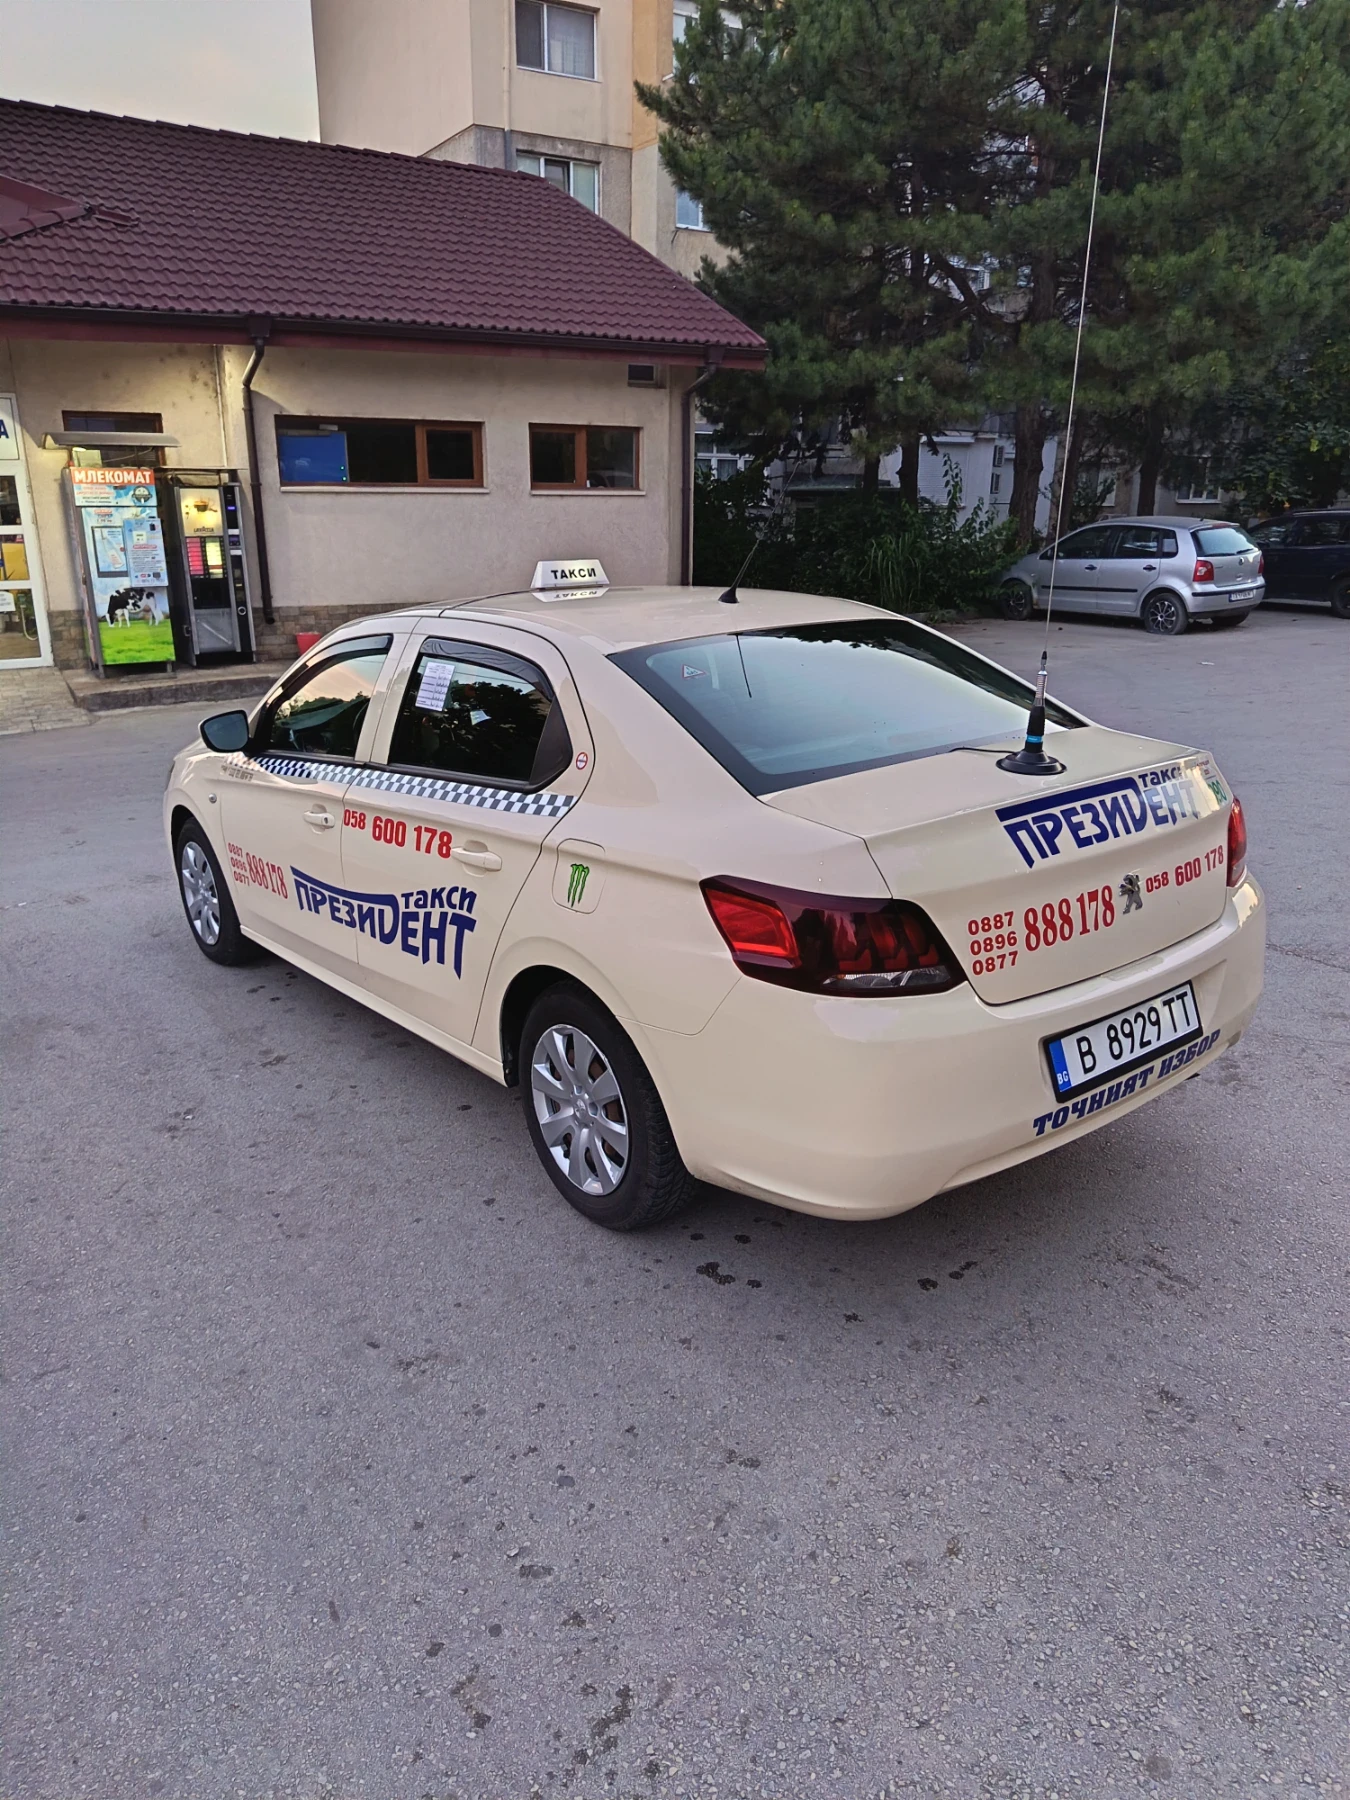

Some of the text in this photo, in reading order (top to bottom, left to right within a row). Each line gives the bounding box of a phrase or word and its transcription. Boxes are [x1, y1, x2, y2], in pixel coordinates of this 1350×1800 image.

[74, 470, 151, 484] МЛЕКОМАТ
[550, 568, 597, 580] ТАКСИ
[343, 808, 453, 859] 058 600 178
[228, 842, 243, 858] 0887
[230, 852, 288, 899] 0896 888178
[233, 871, 250, 886] 0877
[1145, 845, 1224, 894] 058 600 178
[401, 885, 477, 914] такси
[968, 911, 1014, 936] 0887
[969, 885, 1115, 957] 0896 888178
[972, 950, 1018, 976] 0877
[1076, 1036, 1097, 1075] B
[1106, 1006, 1161, 1061] 8929
[1033, 1029, 1221, 1136] ТОЧНИЯТ ИЗБОР
[1057, 1071, 1069, 1085] BG
